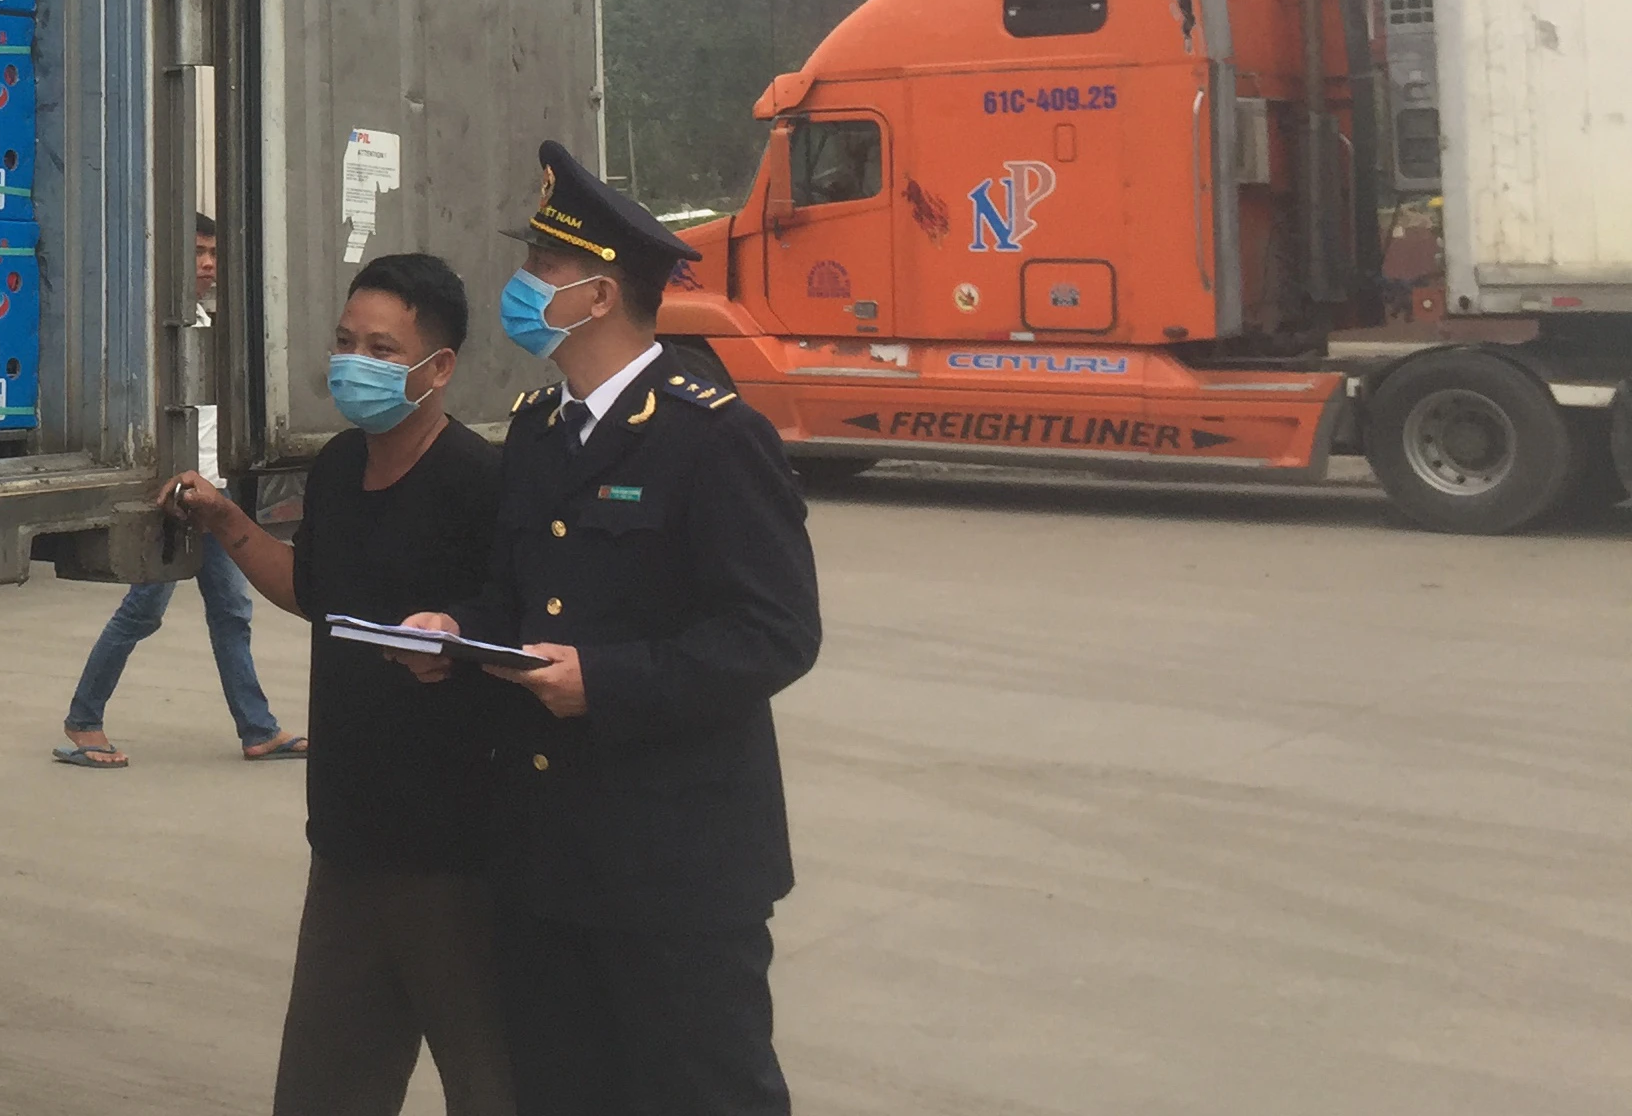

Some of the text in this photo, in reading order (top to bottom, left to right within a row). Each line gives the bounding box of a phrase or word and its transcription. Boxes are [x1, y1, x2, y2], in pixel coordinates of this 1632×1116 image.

[983, 85, 1118, 115] 61C-409.25
[555, 211, 583, 229] NAM
[968, 160, 1056, 252] NP
[946, 352, 1129, 374] CENTURY
[890, 412, 1181, 450] FREIGHTLINER
